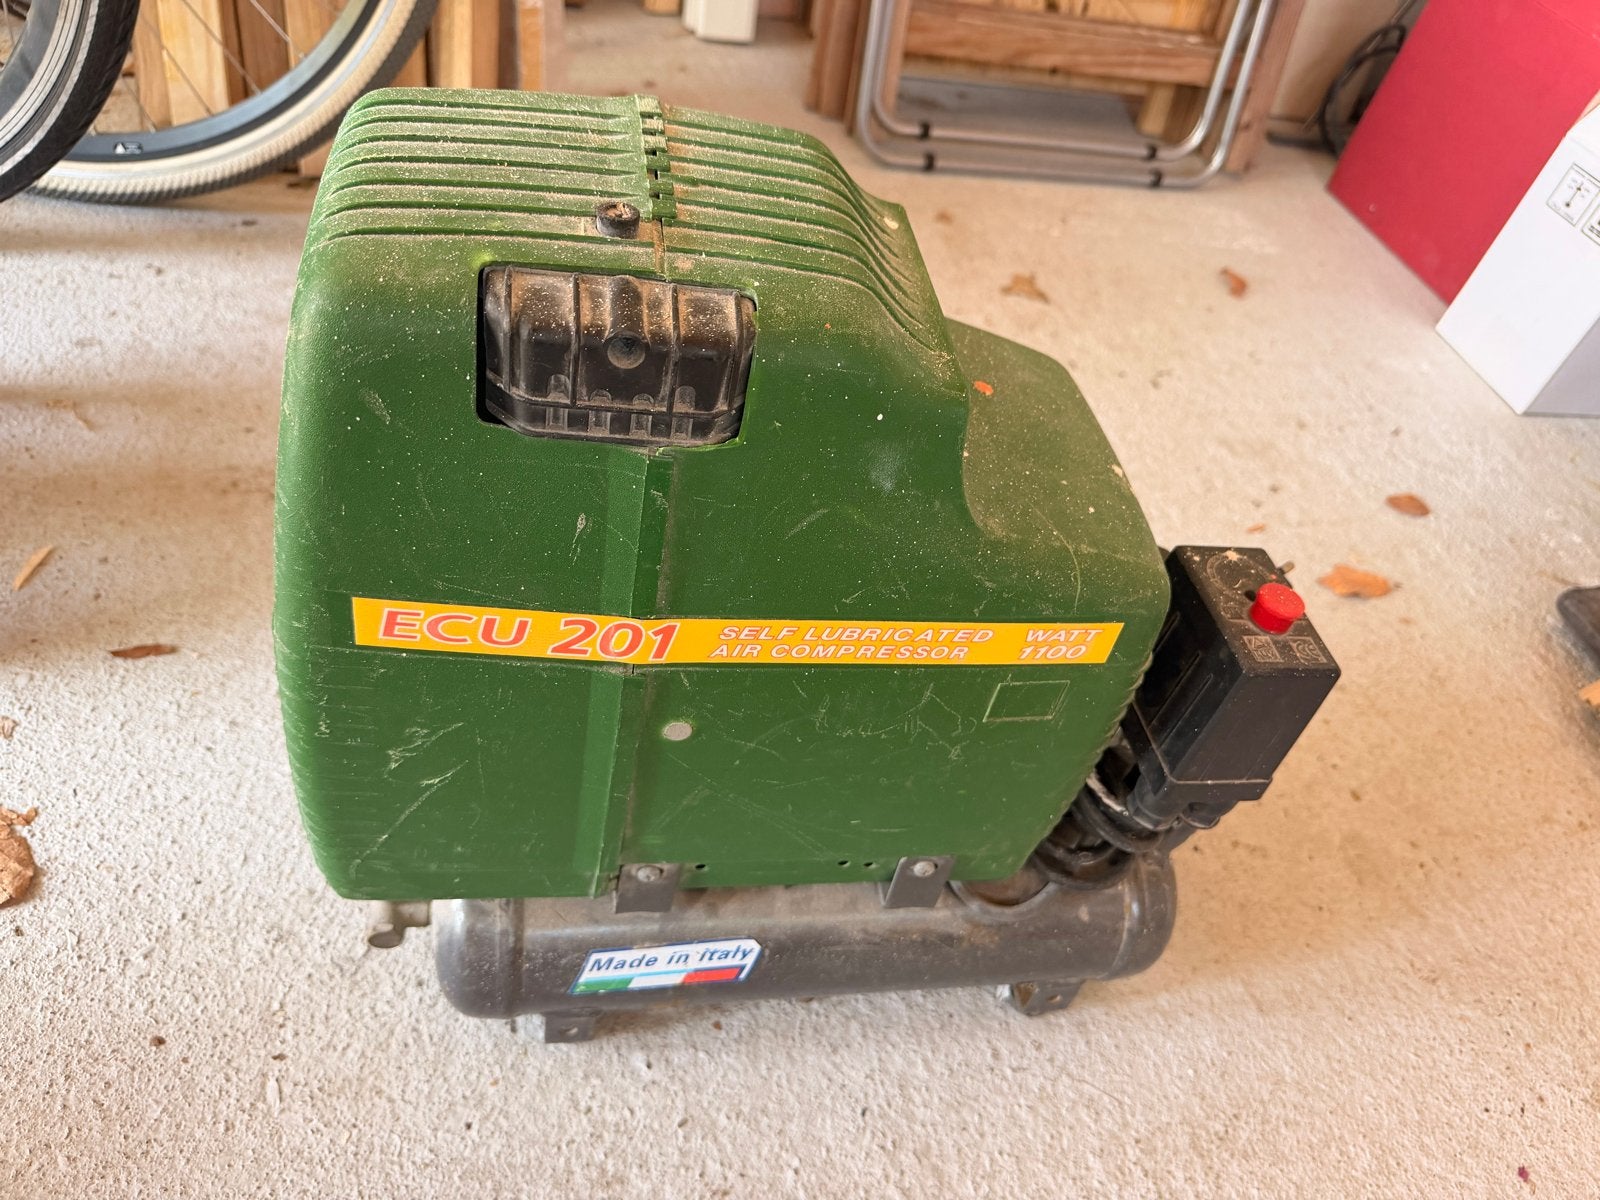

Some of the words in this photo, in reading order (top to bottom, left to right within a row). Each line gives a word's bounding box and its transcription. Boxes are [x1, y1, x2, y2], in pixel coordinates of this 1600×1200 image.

[379, 608, 532, 647] ECU
[548, 617, 680, 661] 201
[719, 626, 798, 641] SELF
[803, 627, 994, 642] LUBRICATED
[1025, 629, 1102, 642] WATT
[709, 644, 762, 658] AIR
[770, 645, 969, 659] COMPRESSOR
[1017, 645, 1087, 659] 1100
[590, 954, 658, 971] Made
[667, 952, 690, 965] in
